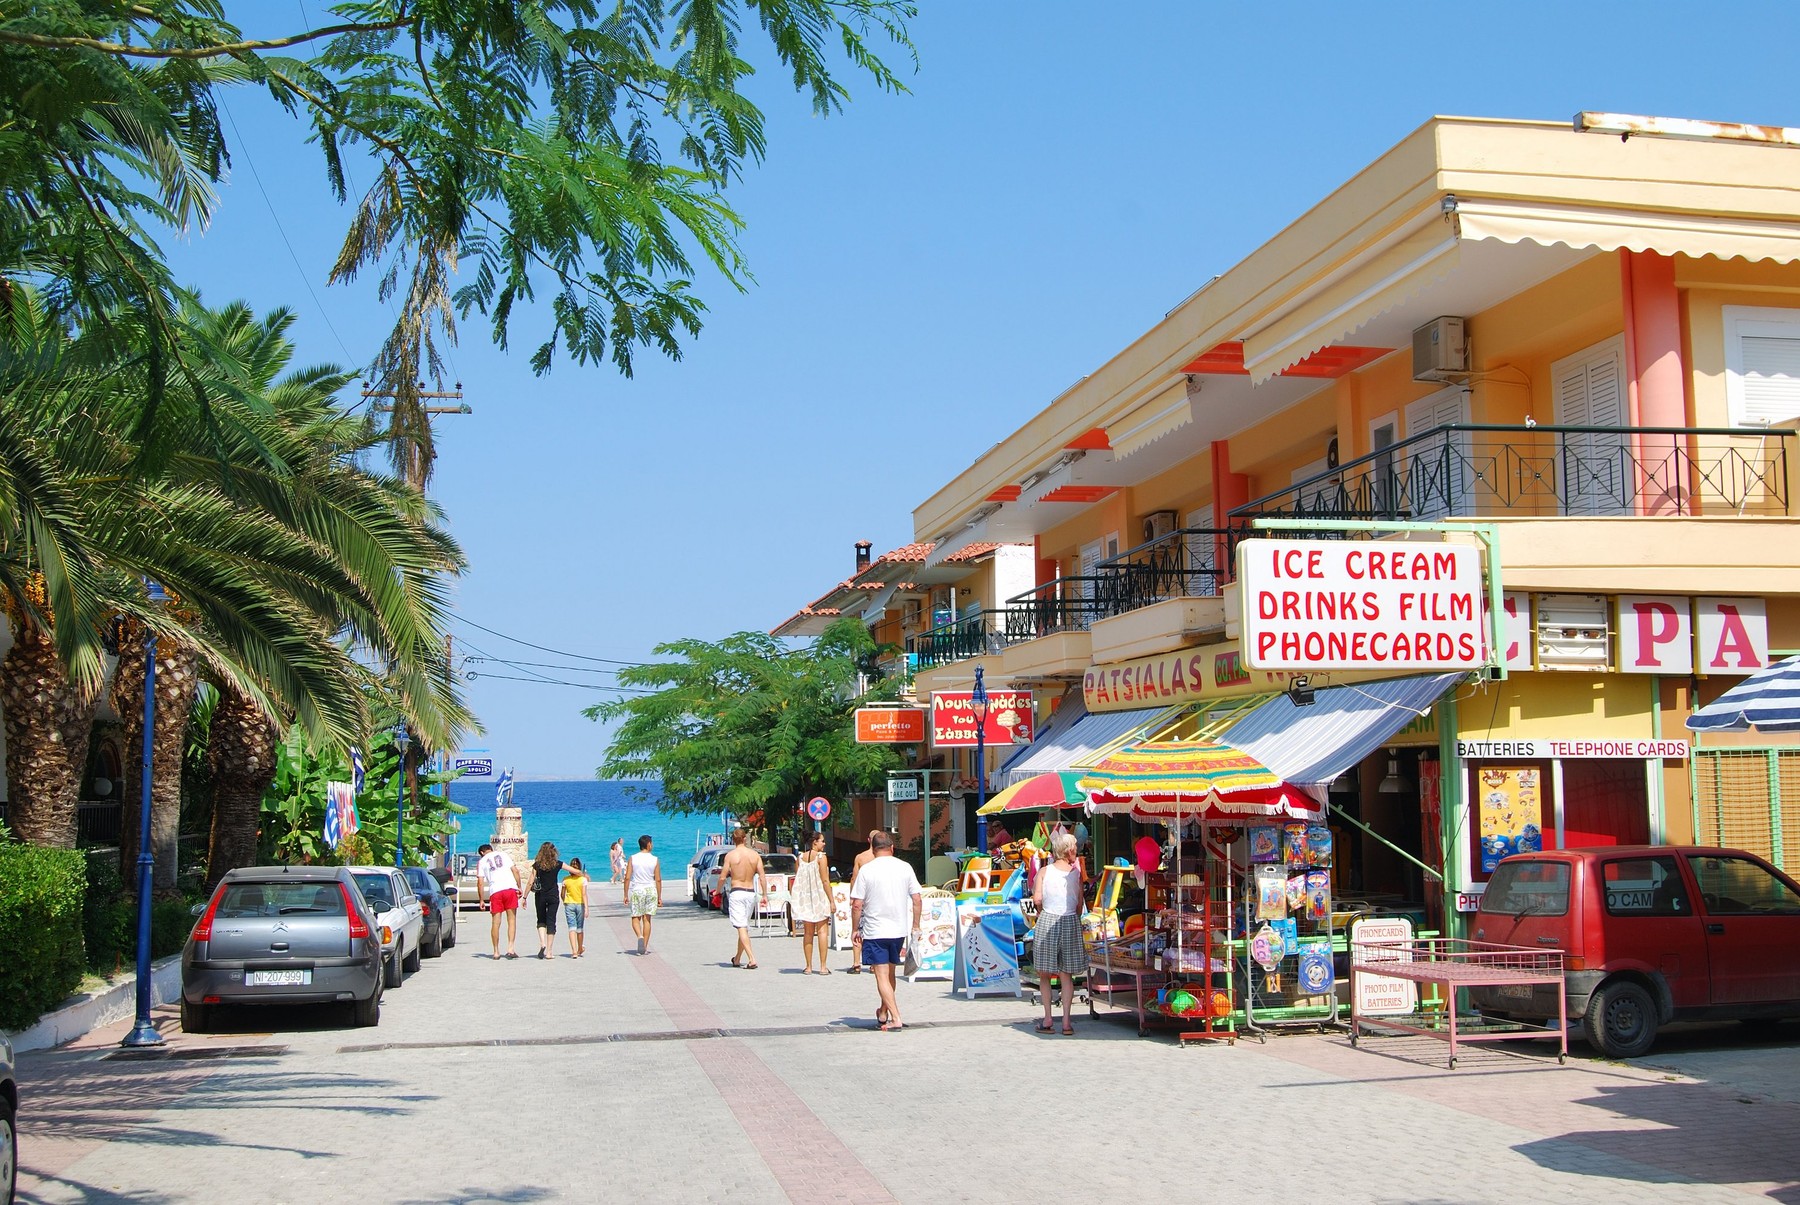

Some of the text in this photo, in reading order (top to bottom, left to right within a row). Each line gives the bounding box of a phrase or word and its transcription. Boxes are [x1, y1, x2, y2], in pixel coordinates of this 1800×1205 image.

[1272, 549, 1457, 581] ICE CREAM
[1258, 591, 1473, 621] DRINKS FILM
[1258, 631, 1475, 662] PHONECARDS
[1084, 654, 1202, 705] PATSIALAS
[870, 722, 911, 731] perfetto
[1457, 742, 1686, 756] BATTERIES TELEPHONE CARDS
[473, 759, 491, 767] PIZZA
[892, 781, 914, 789] PIZZA
[890, 790, 917, 798] TAKE OUT
[486, 854, 504, 871] 10
[1360, 928, 1404, 938] PHONECARDS
[1364, 983, 1404, 993] PHOTO FILM
[1367, 997, 1403, 1008] BATTERIES
